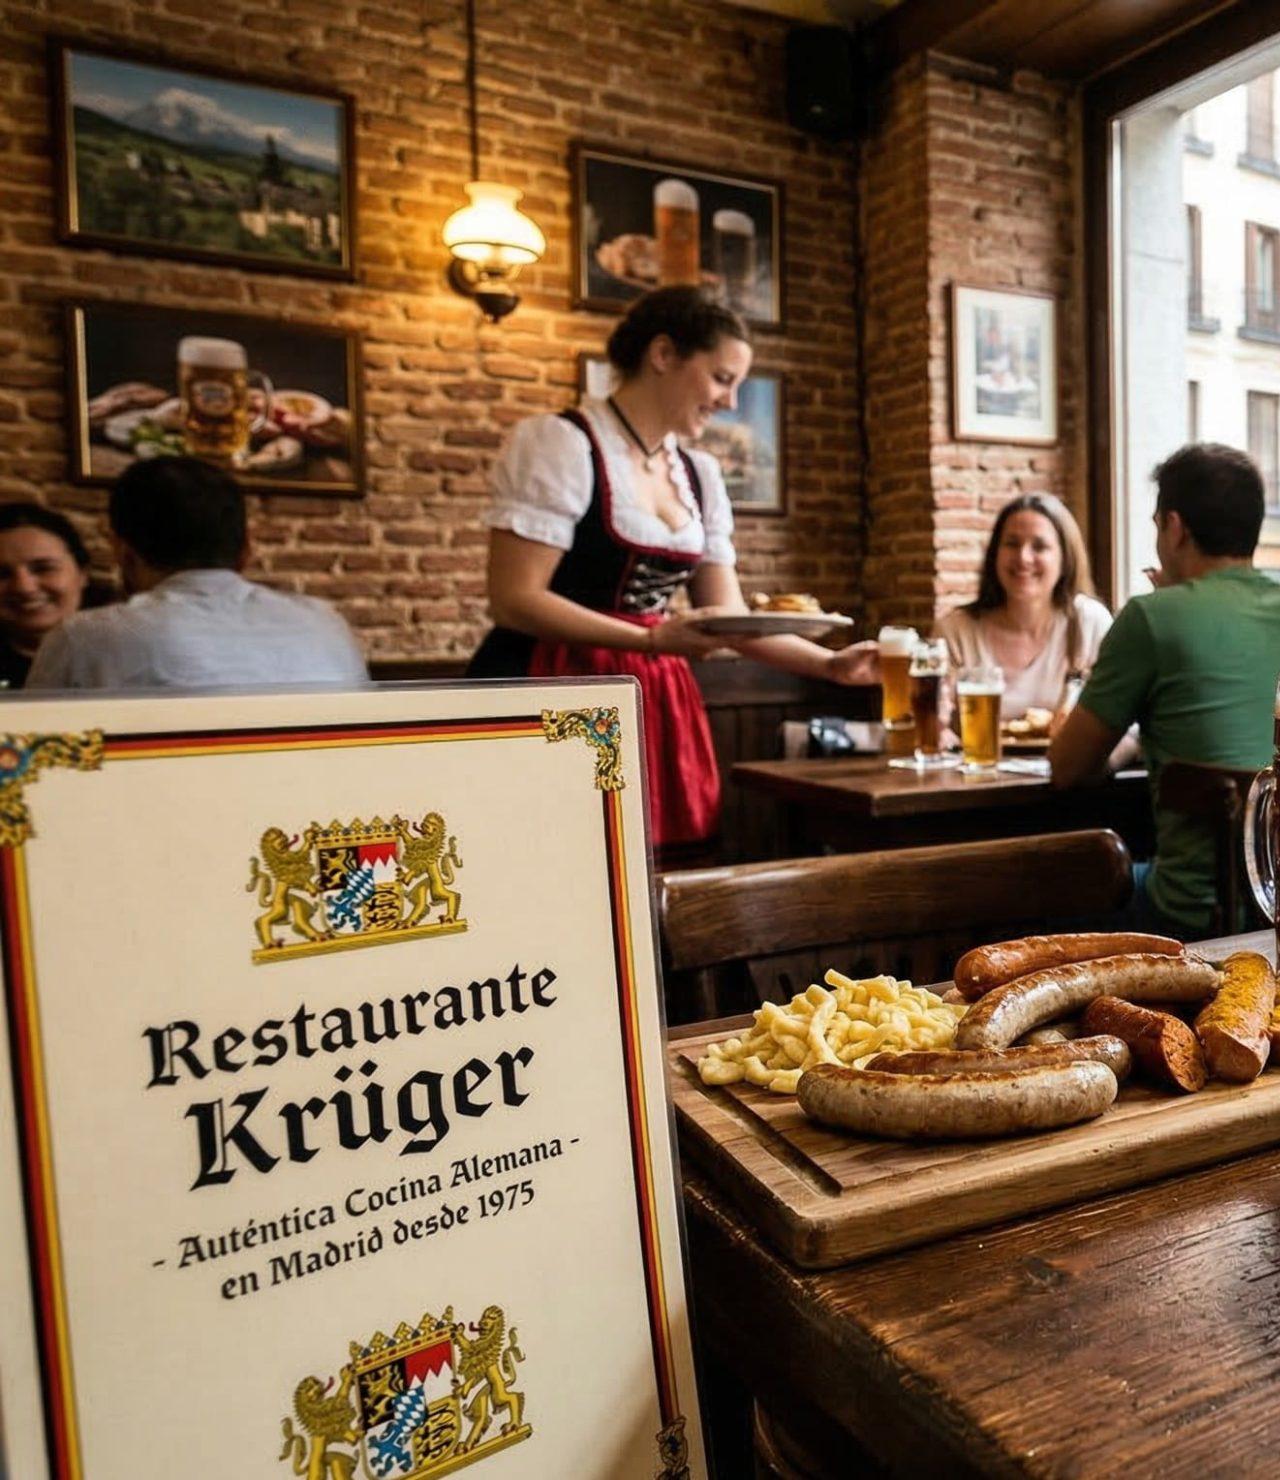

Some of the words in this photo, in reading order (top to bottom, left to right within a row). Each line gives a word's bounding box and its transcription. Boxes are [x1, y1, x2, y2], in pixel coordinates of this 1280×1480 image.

[142, 963, 557, 1090] Restaurante
[184, 1046, 535, 1192] Krüger
[178, 1205, 336, 1269] Auténtica
[345, 1173, 442, 1218] Cocina
[450, 1138, 563, 1189] Alemana
[220, 1271, 260, 1301] en
[269, 1226, 384, 1286] Madrid
[392, 1203, 470, 1245] desde
[477, 1179, 535, 1219] 1975
